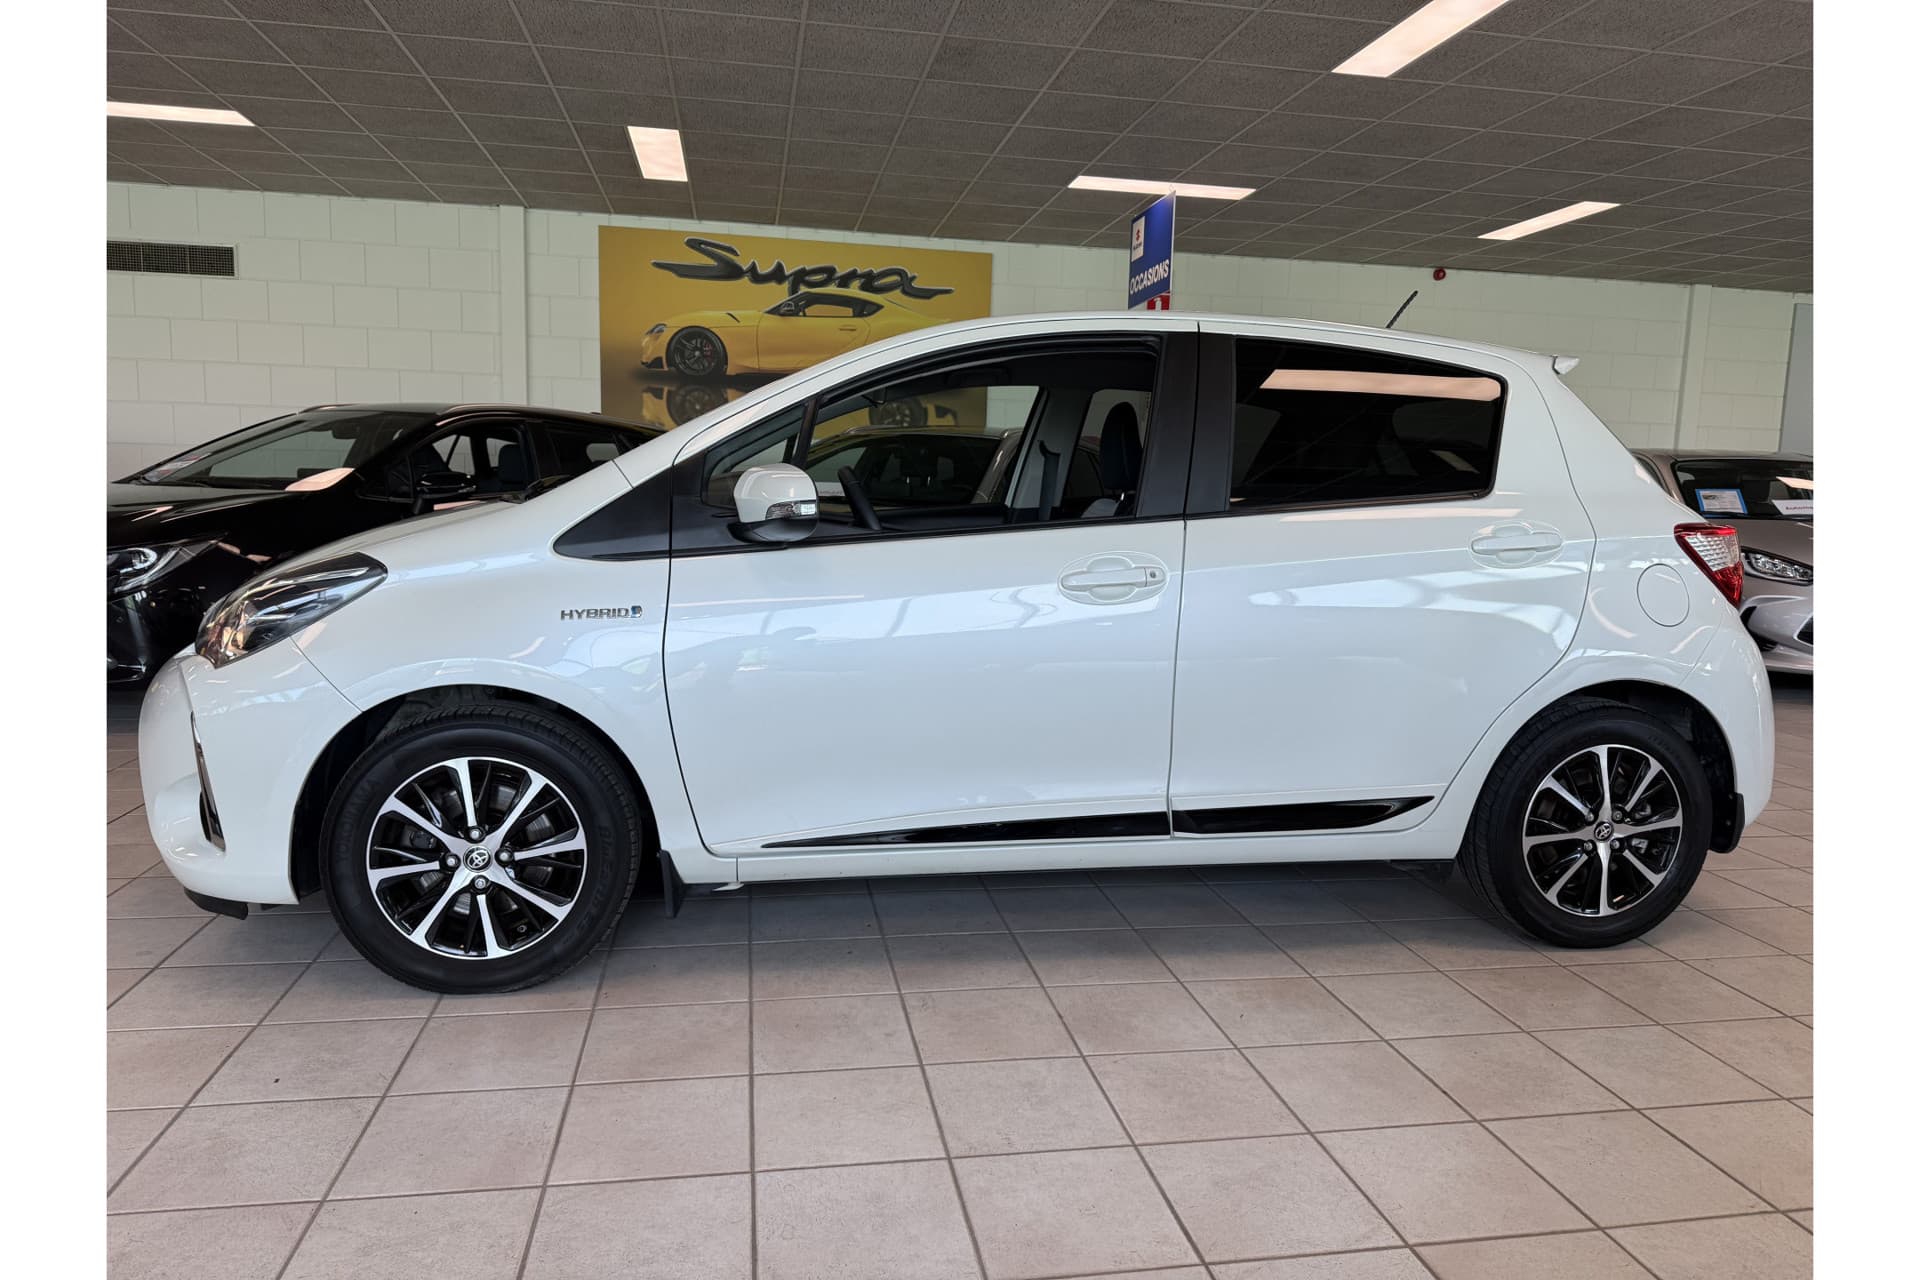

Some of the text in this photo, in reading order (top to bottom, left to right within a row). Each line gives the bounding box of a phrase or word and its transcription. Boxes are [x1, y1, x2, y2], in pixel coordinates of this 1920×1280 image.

[651, 237, 955, 299] Supra
[1129, 260, 1169, 294] OCCASIONS
[560, 607, 630, 620] HYBRID
